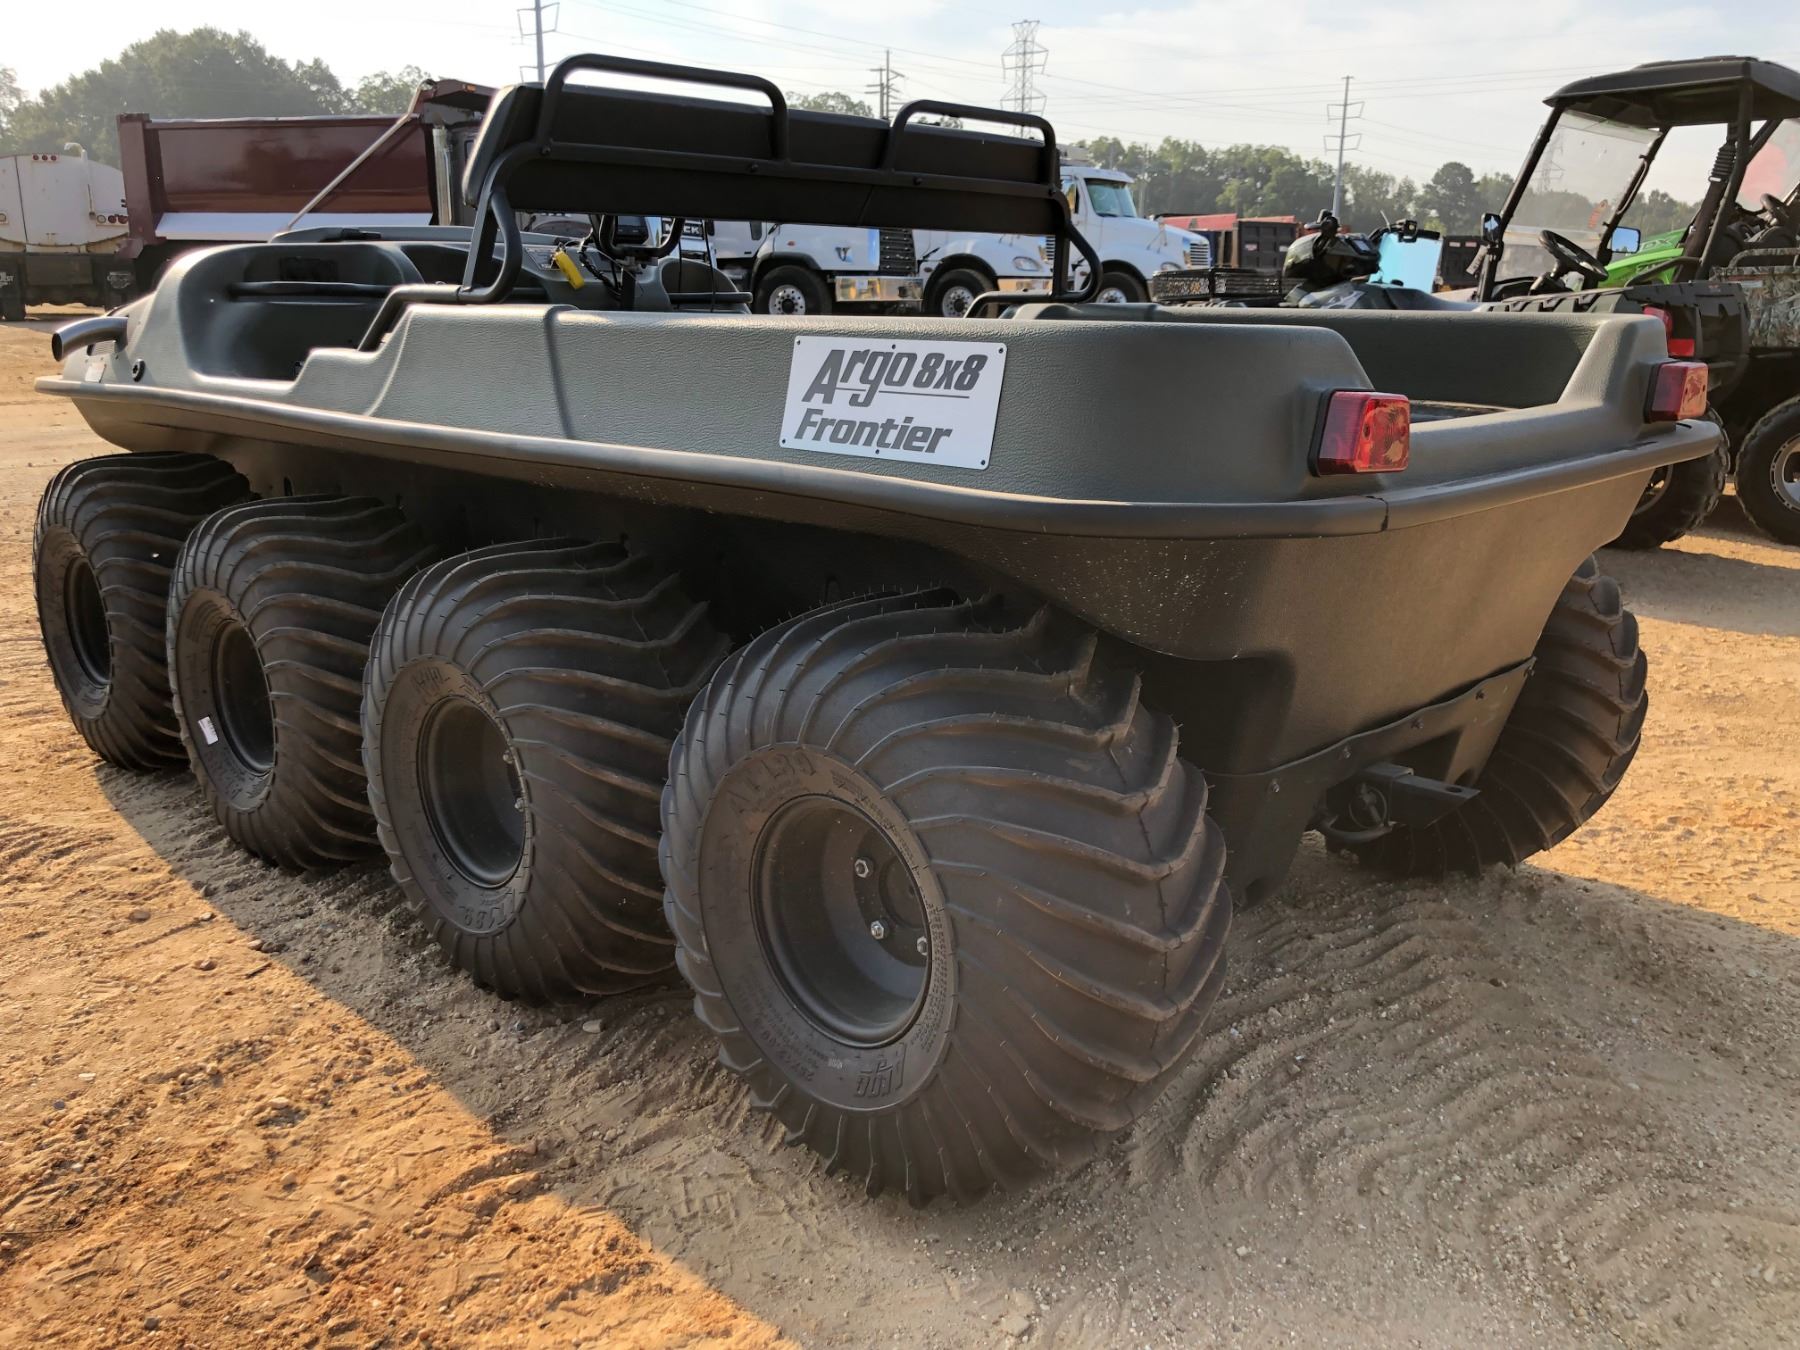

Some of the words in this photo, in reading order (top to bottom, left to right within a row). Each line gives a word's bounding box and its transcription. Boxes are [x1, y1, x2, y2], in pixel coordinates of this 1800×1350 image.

[801, 349, 918, 408] Argo
[912, 352, 988, 391] 8x8
[794, 408, 953, 454] Frontier
